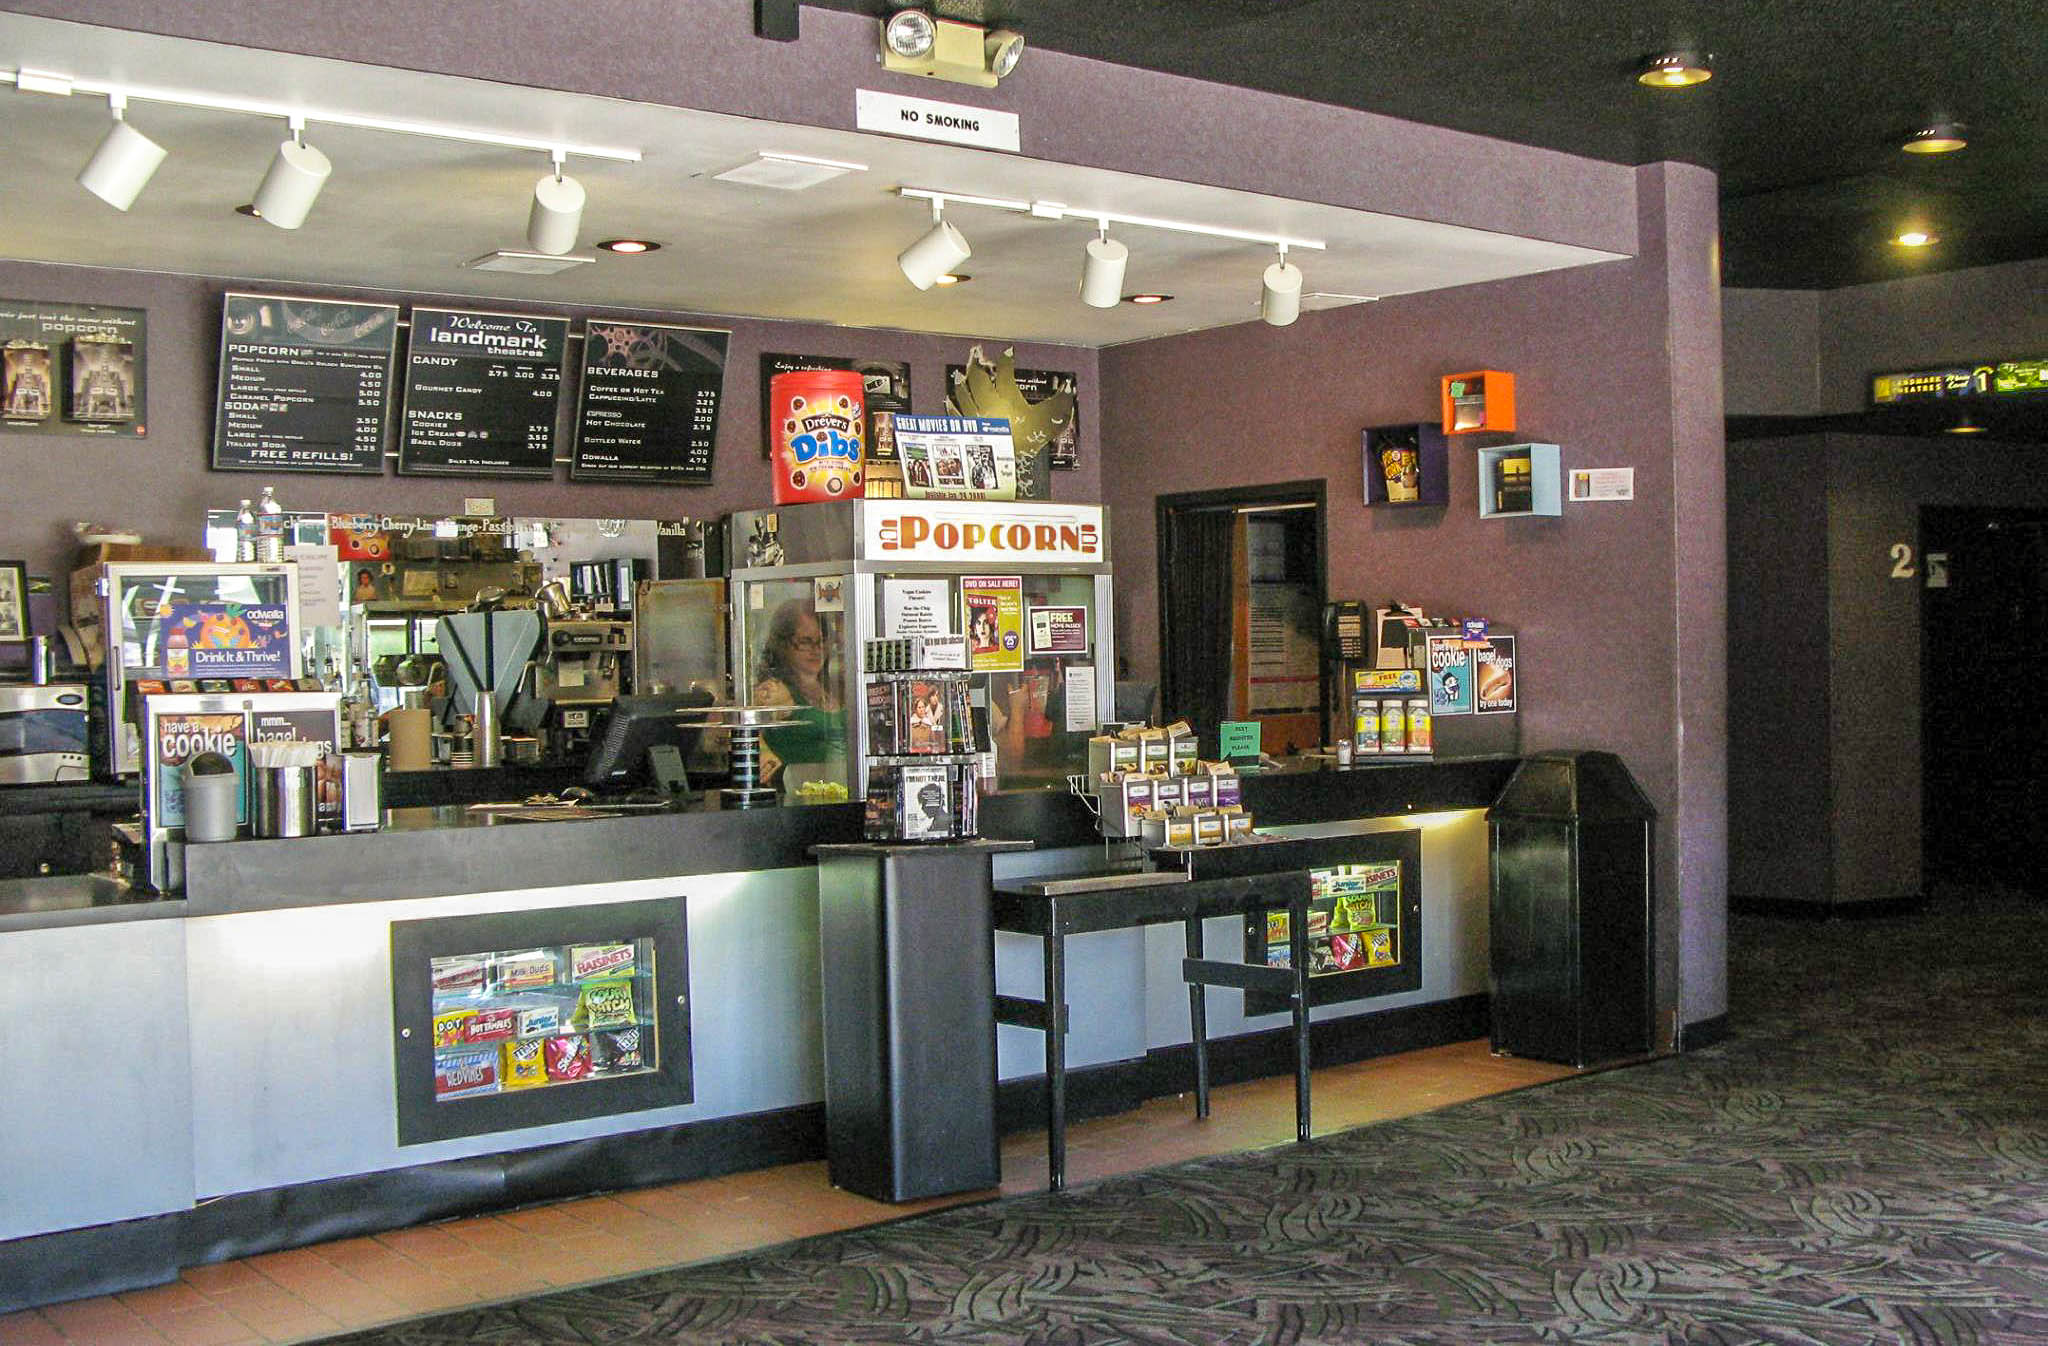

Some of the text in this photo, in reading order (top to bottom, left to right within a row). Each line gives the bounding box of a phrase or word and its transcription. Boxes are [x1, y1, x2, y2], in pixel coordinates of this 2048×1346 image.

[900, 109, 980, 132] NO SMOKING
[42, 322, 118, 334] popcorn
[449, 316, 537, 334] Welcome To
[430, 327, 548, 350] landmark
[228, 344, 300, 356] POPCORN
[487, 347, 544, 358] theatres
[413, 356, 458, 366] CANDY
[587, 366, 659, 378] BEVERAGES
[225, 401, 260, 411] SODA
[408, 410, 463, 421] SNACKS
[896, 416, 918, 431] GREAT
[918, 419, 948, 432] MOVIES
[950, 419, 961, 432] ON
[962, 419, 978, 433] DVD
[790, 431, 860, 462] Dibs
[251, 449, 353, 461] FREE REFILLS!
[900, 515, 1079, 551] POPCORN
[1890, 543, 1915, 579] 2
[246, 609, 284, 620] odwalla
[1050, 612, 1074, 623] FREE
[195, 650, 280, 663] Drink It & Thrive!
[1432, 645, 1465, 667] cookie
[1478, 648, 1496, 665] bagel
[164, 721, 198, 733] have a
[162, 728, 237, 757] cookie
[576, 948, 632, 974] RAISINETS
